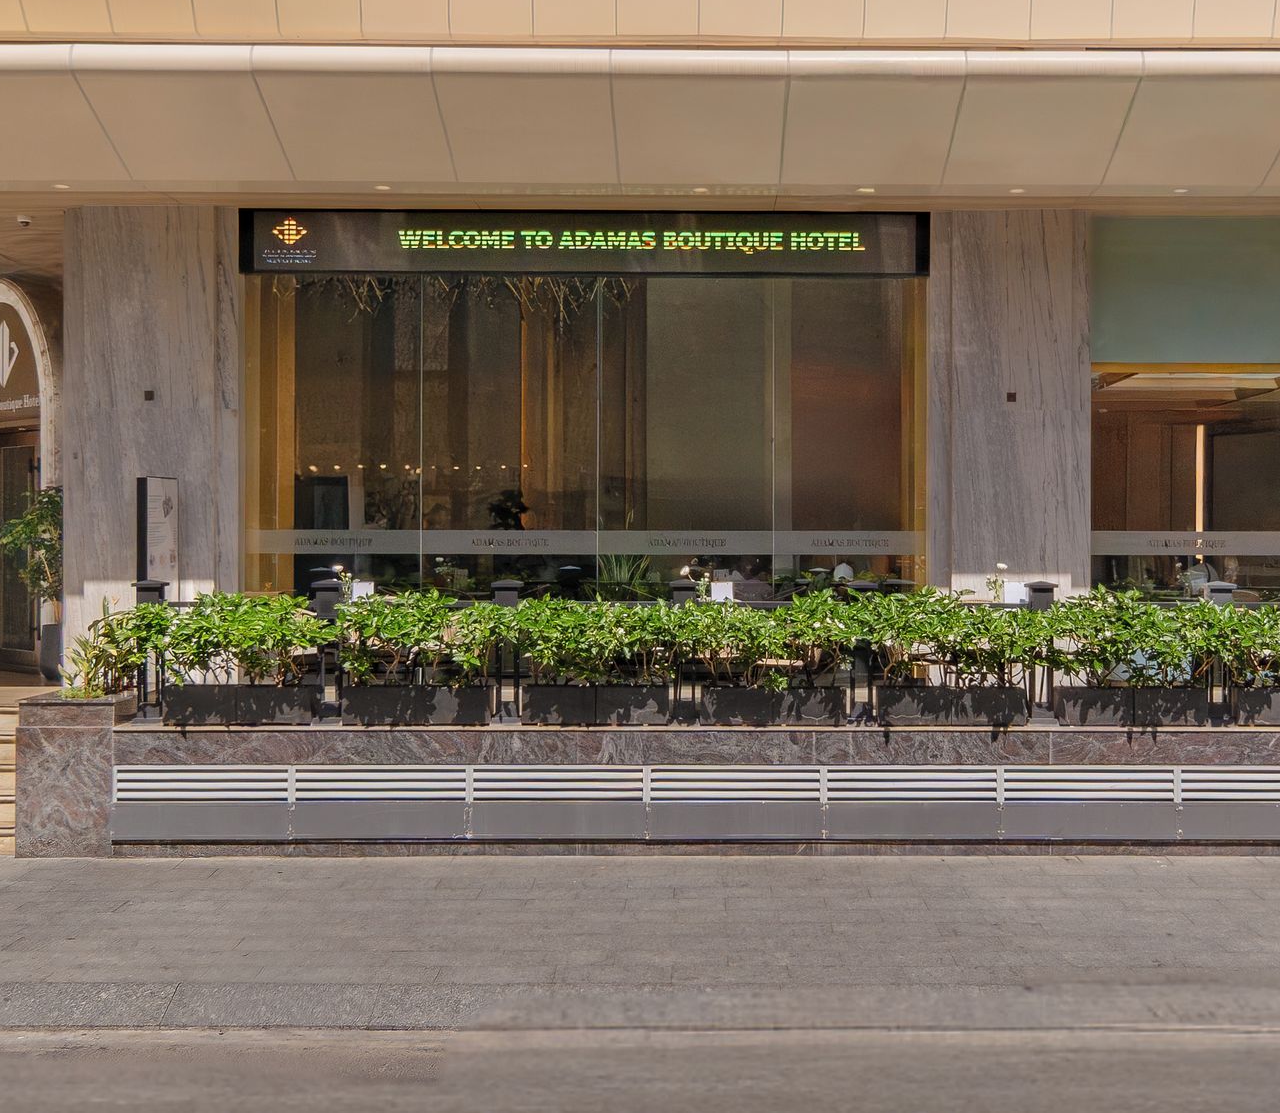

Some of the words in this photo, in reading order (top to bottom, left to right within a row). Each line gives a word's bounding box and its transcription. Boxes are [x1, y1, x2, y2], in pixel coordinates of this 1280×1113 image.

[398, 230, 515, 250] WELCOME
[520, 230, 553, 250] TO
[558, 230, 657, 251] ADAMAS
[663, 231, 784, 255] BOUTIQUE
[790, 231, 866, 251] HOTEL
